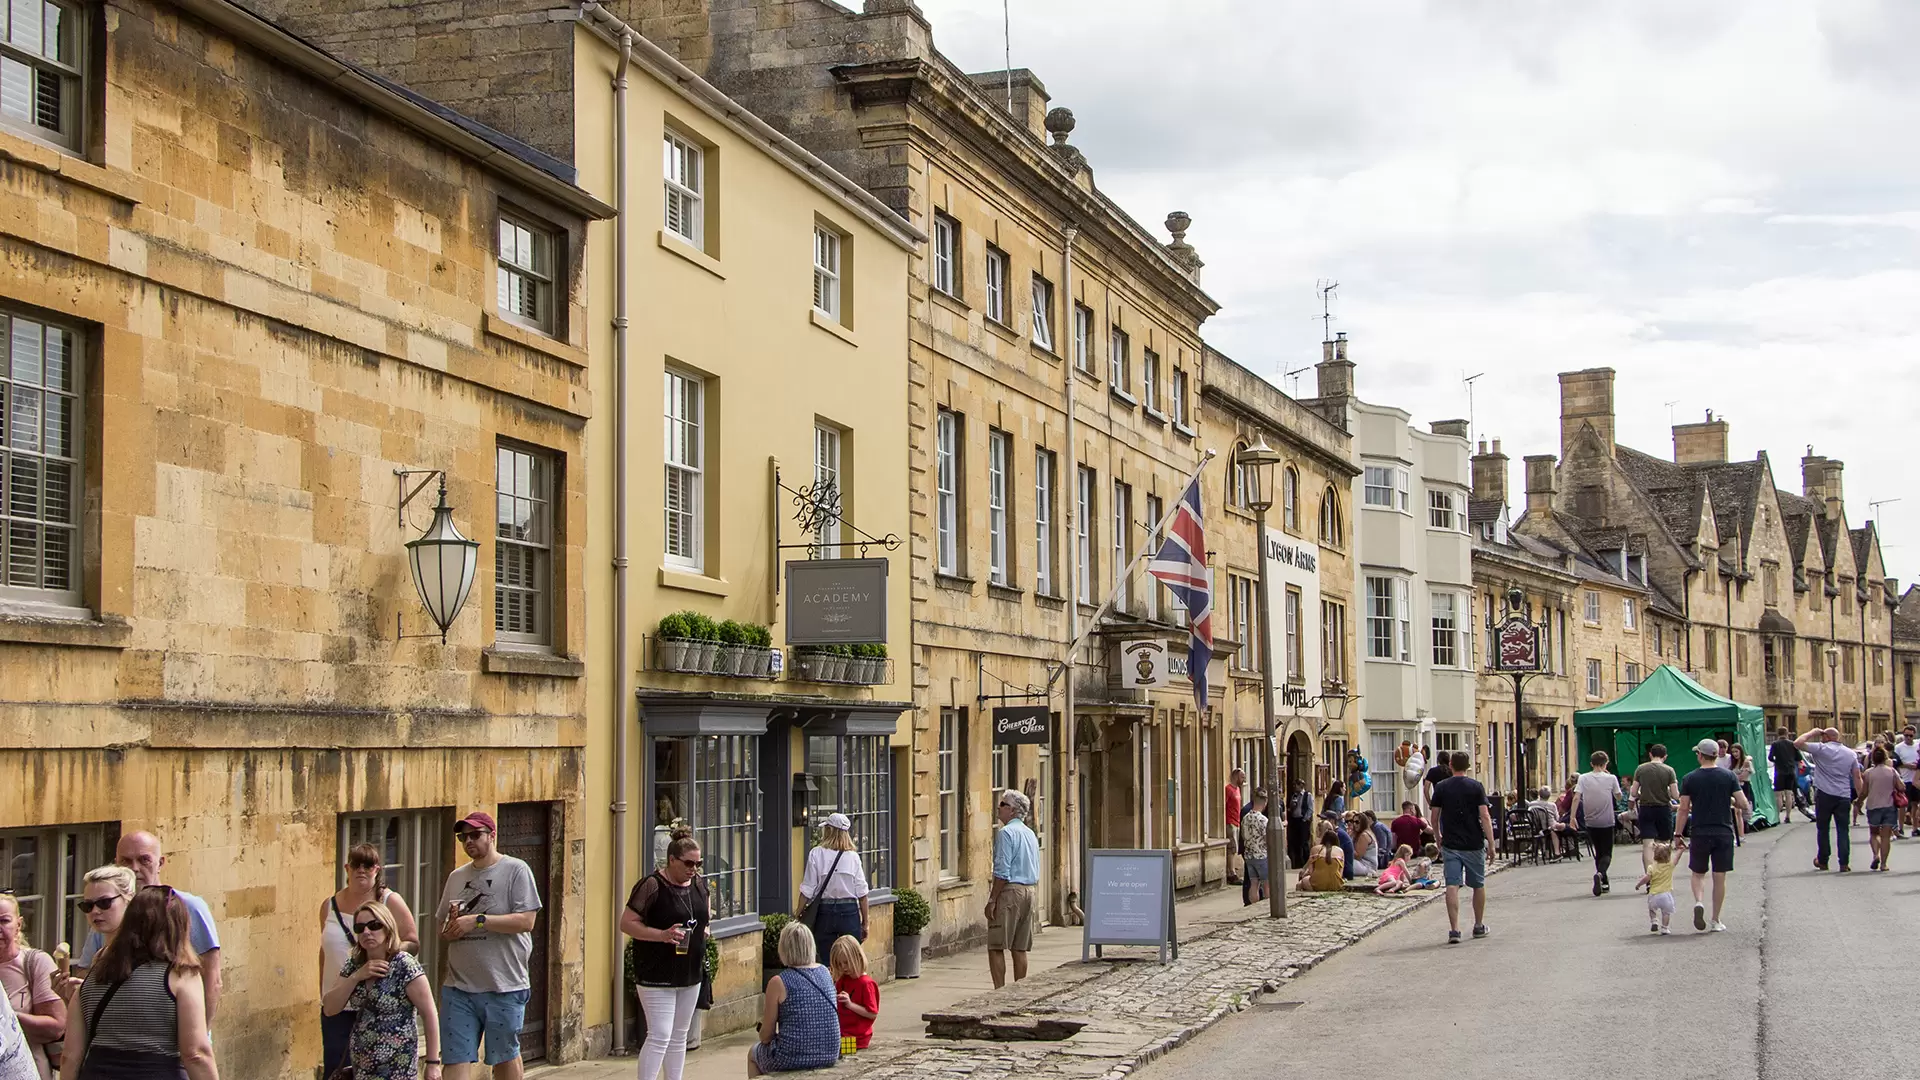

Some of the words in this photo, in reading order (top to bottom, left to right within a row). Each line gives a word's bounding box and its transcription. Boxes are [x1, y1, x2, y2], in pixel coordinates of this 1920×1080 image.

[1266, 535, 1292, 564] LYGON
[1294, 546, 1314, 573] ARMS
[803, 593, 870, 604] ACADEMY
[1282, 684, 1307, 707] HOTEL
[998, 718, 1026, 733] CHERRY
[1020, 716, 1045, 734] PRESS
